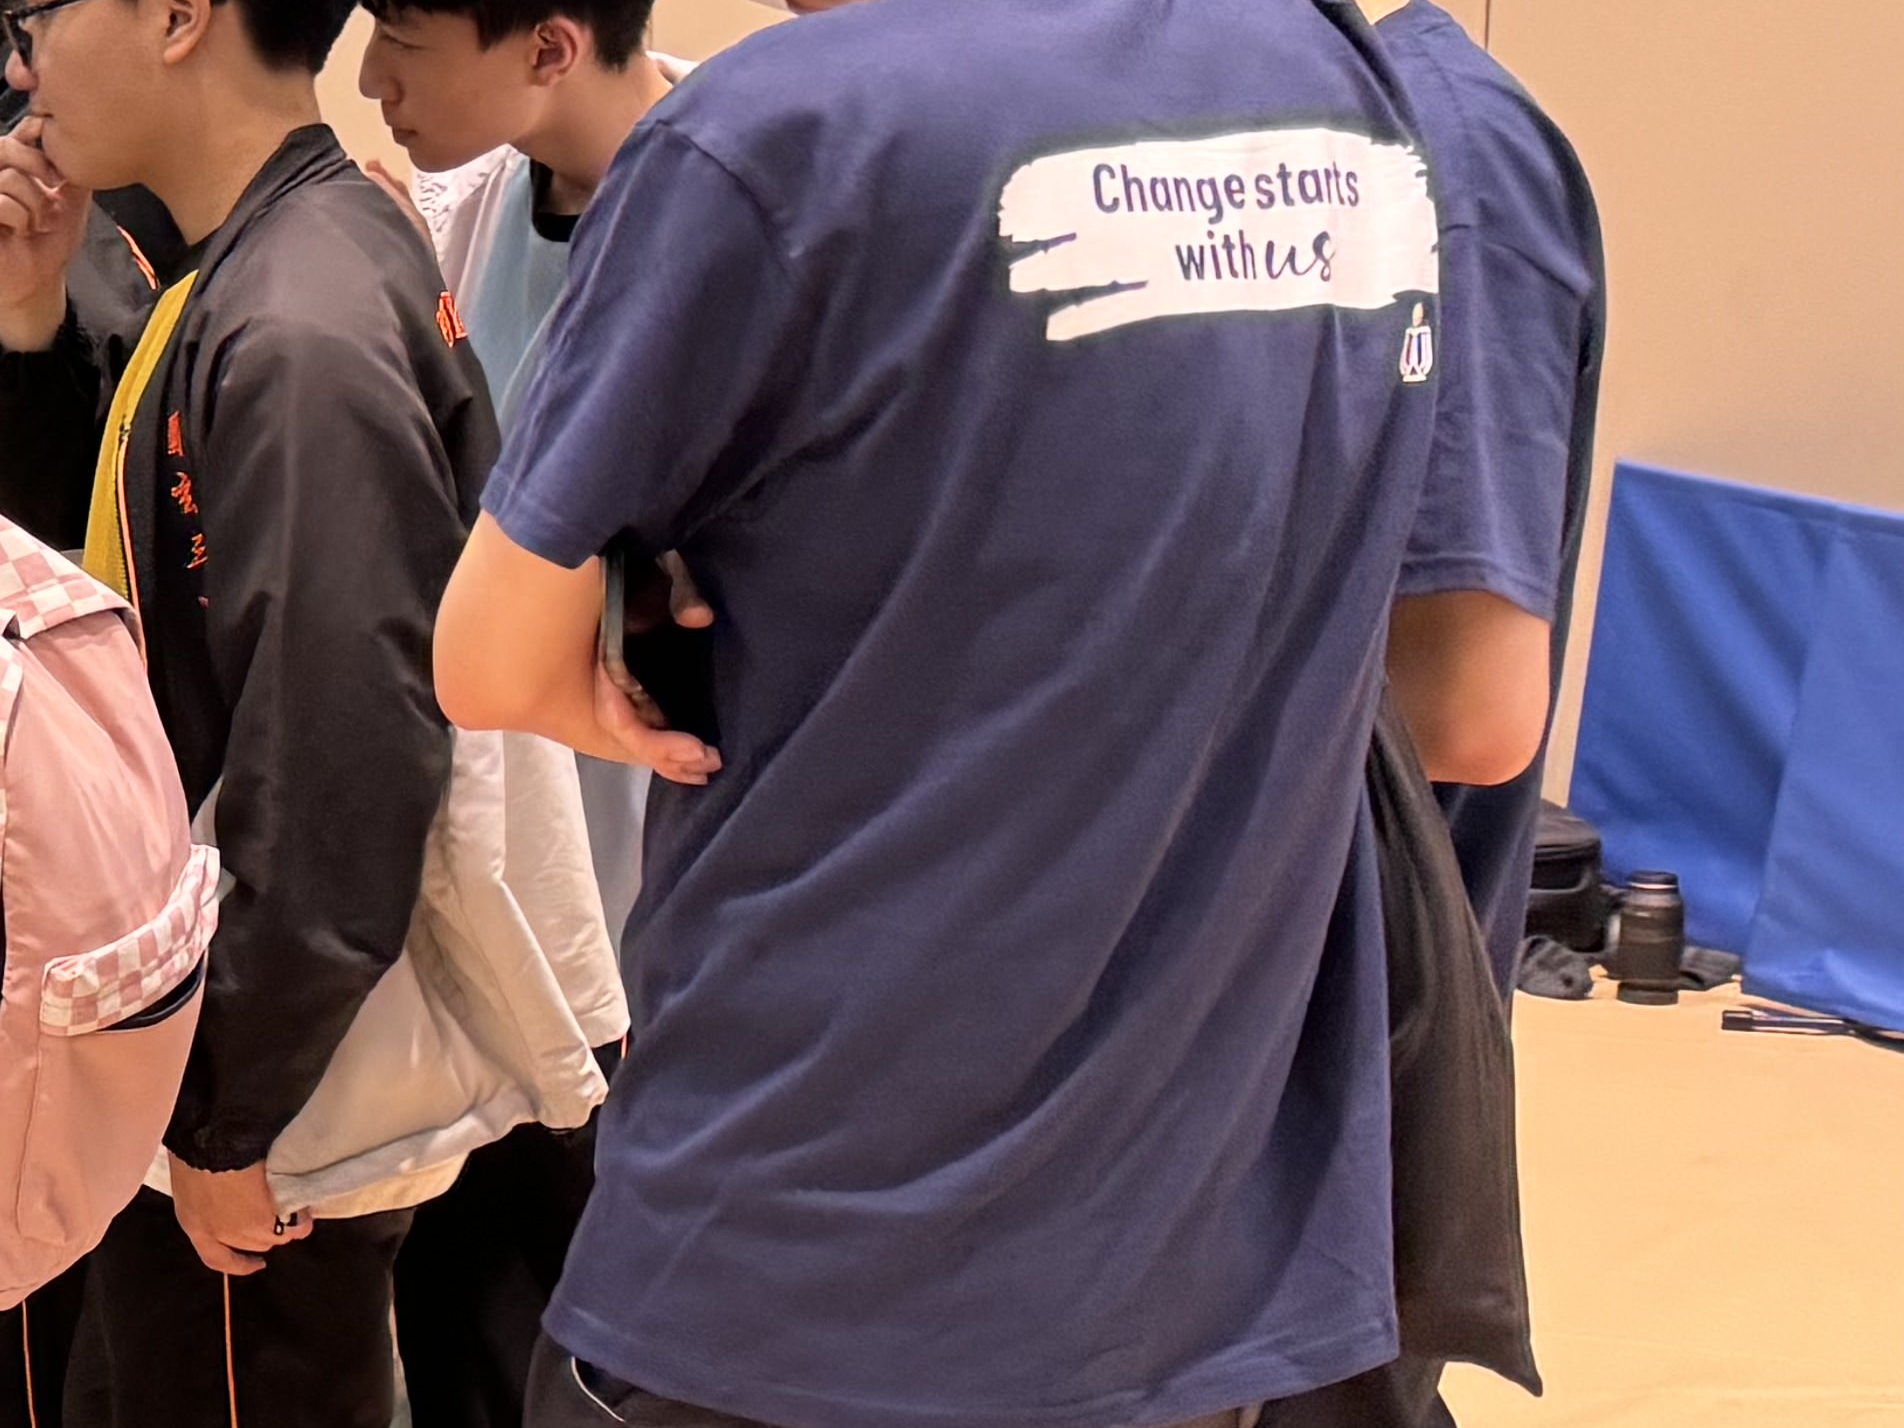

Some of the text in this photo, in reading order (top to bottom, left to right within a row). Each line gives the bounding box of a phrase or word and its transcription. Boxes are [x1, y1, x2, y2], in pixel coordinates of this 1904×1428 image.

[1093, 161, 1360, 225] Change starts
[1175, 229, 1336, 282] with us
